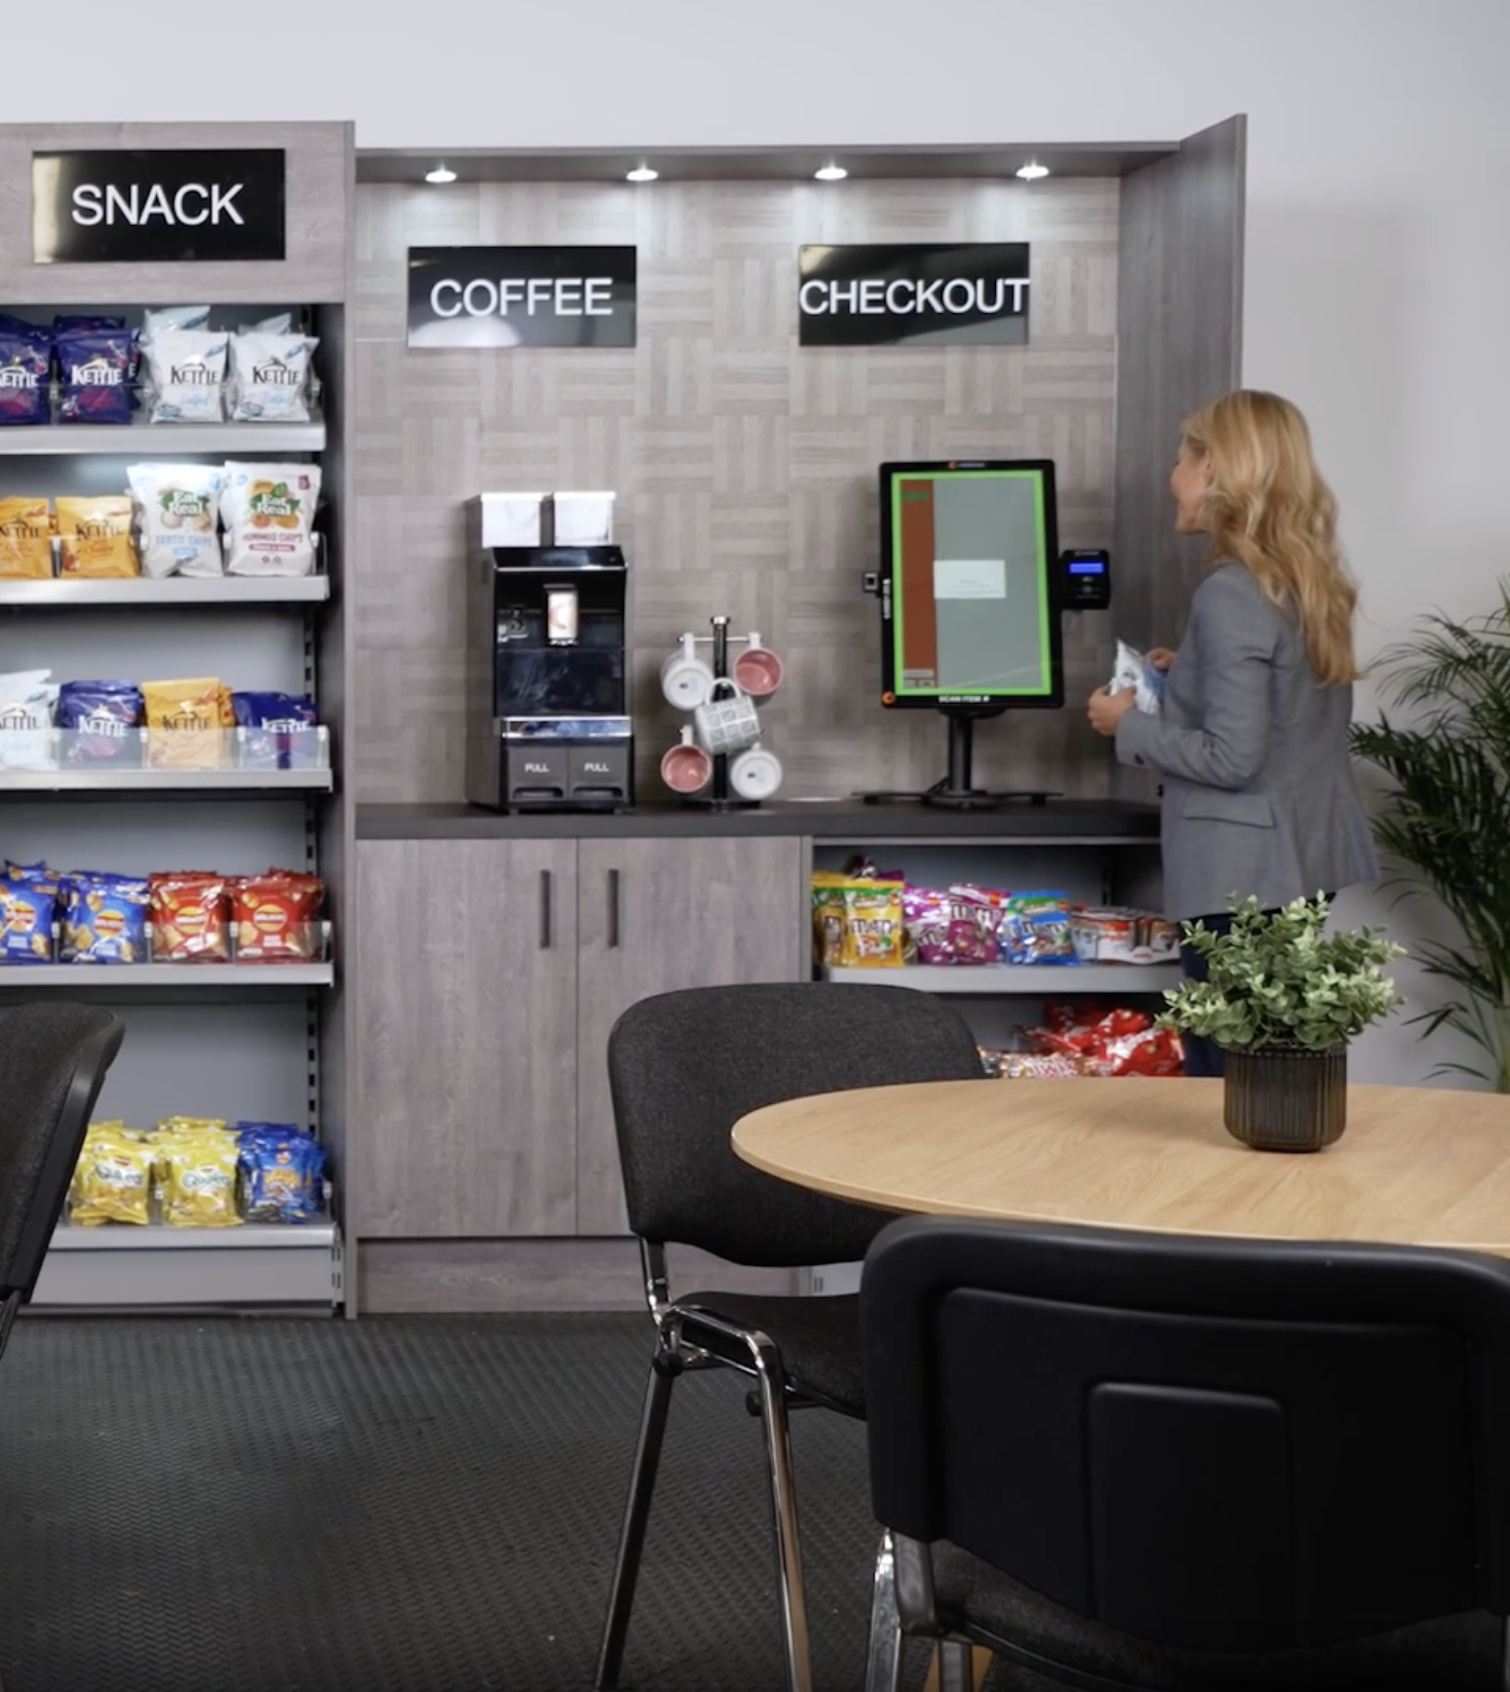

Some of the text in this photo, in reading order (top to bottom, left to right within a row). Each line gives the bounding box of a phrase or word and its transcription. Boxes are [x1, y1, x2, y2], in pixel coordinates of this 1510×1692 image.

[71, 184, 245, 227] SNACK
[429, 277, 614, 318] COFFEE
[799, 277, 1030, 316] CHECKOUT
[71, 361, 123, 385] KETTLE
[170, 363, 219, 385] KETTLE
[253, 363, 300, 385] KETTLE
[169, 501, 203, 516] Real
[256, 502, 290, 516] Real
[77, 712, 128, 737] KETTLE
[524, 762, 550, 773] PULL
[584, 762, 610, 772] PULL
